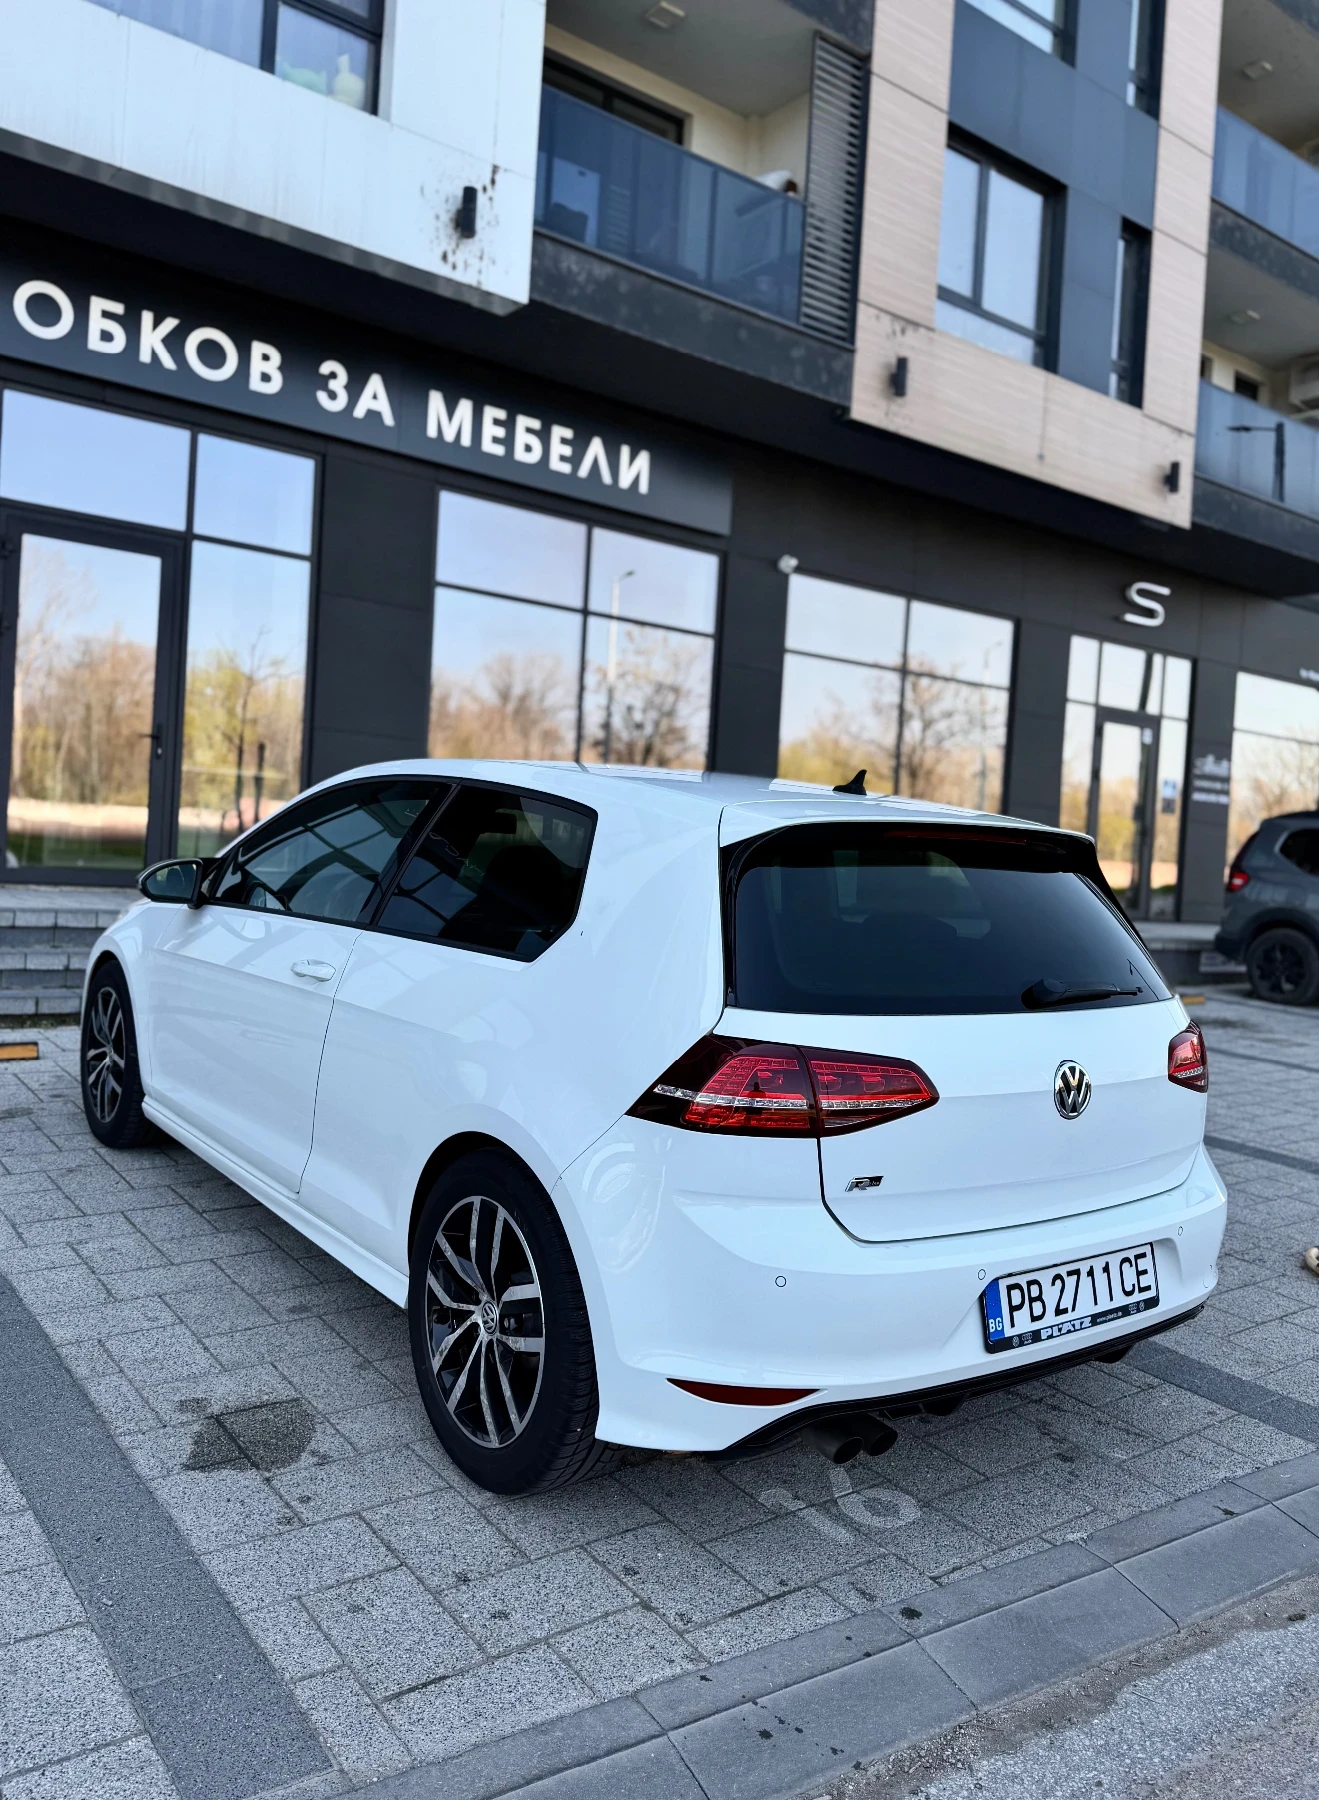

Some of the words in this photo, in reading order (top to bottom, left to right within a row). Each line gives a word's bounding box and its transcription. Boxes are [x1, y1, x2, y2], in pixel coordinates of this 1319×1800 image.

[13, 280, 284, 396] ОБКОВ
[315, 359, 395, 427] ЗА
[426, 389, 651, 495] МЕБЕЛИ
[1123, 581, 1172, 627] S
[1006, 1278, 1047, 1329] PB
[1051, 1260, 1114, 1318] 2711
[1119, 1251, 1152, 1297] CE
[989, 1316, 1003, 1333] BG
